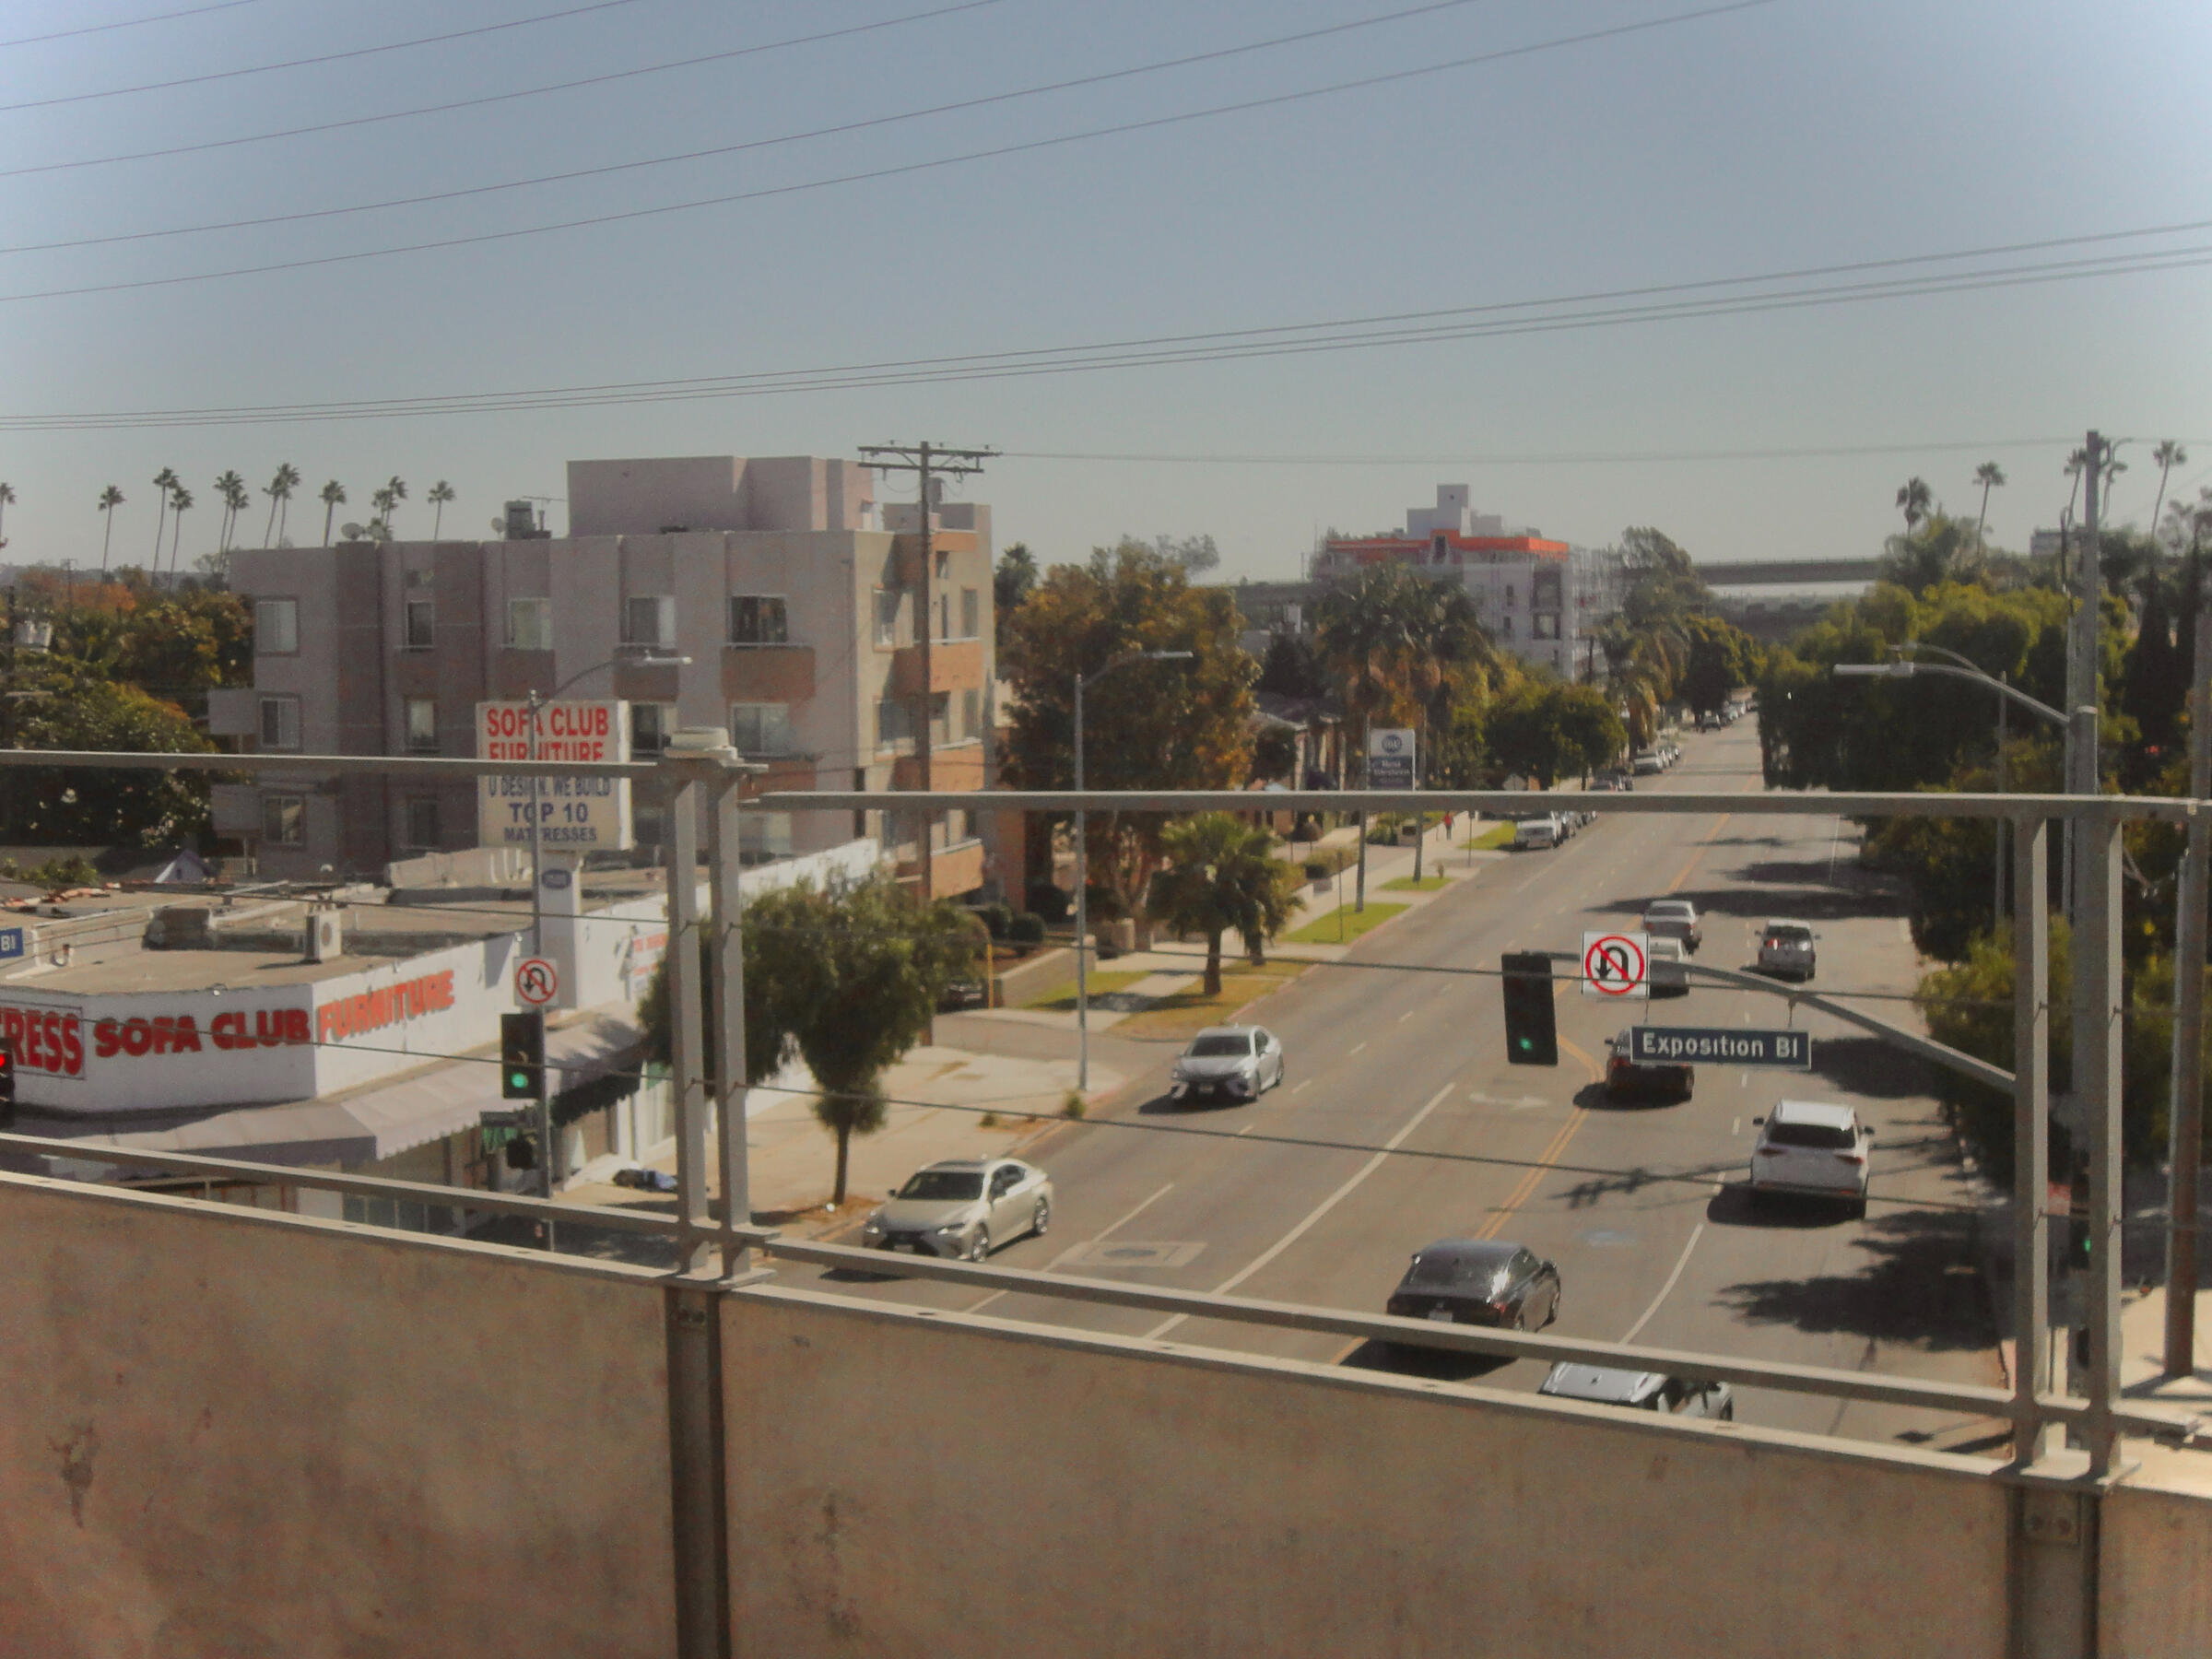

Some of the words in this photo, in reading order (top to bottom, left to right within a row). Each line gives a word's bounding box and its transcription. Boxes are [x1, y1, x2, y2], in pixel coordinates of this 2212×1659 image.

[550, 707, 609, 736] CLUB
[509, 802, 554, 823] TOP
[563, 802, 589, 823] 10
[503, 828, 598, 842] MATRESSES
[316, 970, 455, 1045] FURNITURE
[0, 1006, 84, 1076] RESS
[94, 1016, 202, 1058] SOFA
[210, 1008, 311, 1051] CLUB
[1641, 1031, 1764, 1056] Exposition
